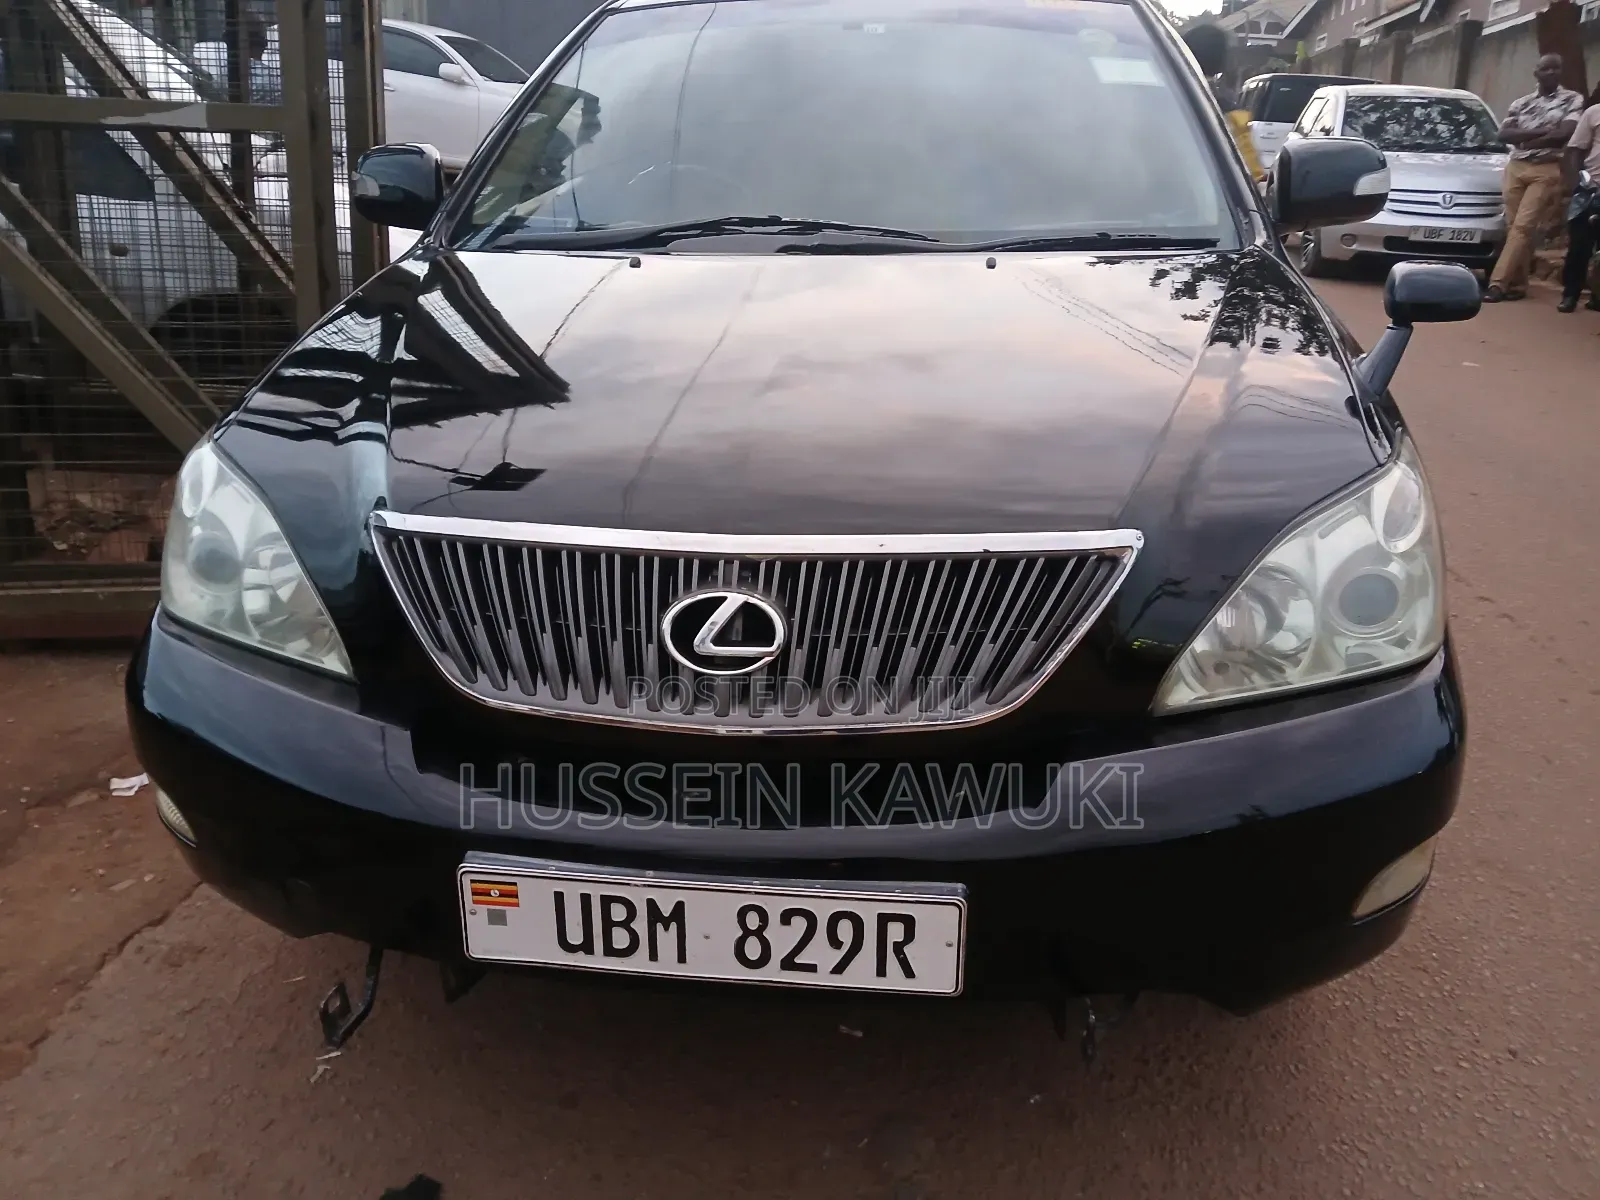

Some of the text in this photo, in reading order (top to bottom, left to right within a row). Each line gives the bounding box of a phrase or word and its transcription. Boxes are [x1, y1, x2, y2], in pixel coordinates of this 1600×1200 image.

[1423, 227, 1477, 241] UBF 182V
[553, 890, 917, 979] UBM 829R
